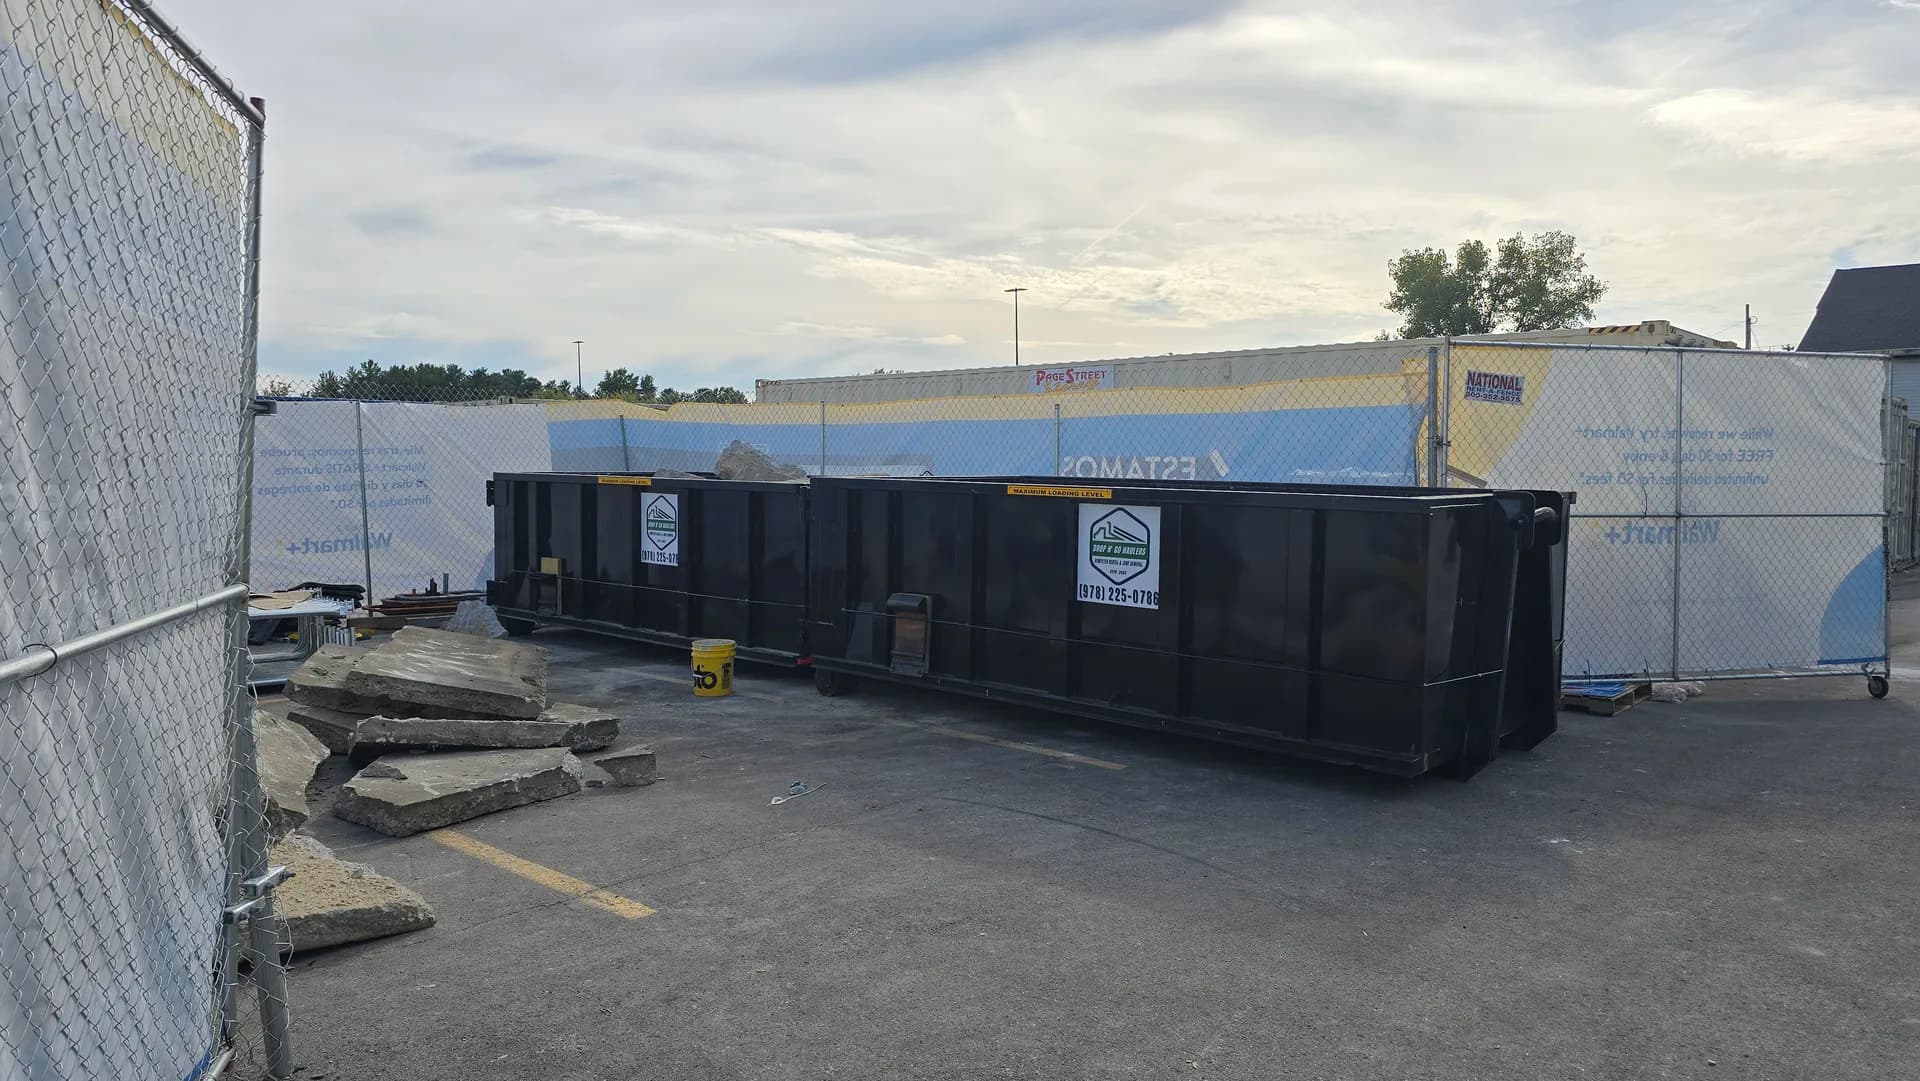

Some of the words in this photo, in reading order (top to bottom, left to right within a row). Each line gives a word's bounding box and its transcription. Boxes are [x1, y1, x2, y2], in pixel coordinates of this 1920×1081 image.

[1467, 370, 1521, 391] NATIONAL
[1467, 385, 1520, 396] RENT-A-FENCE
[1013, 487, 1046, 495] MAXIMUM
[1048, 489, 1079, 497] LOADING
[1081, 490, 1105, 498] LEVEL
[1113, 545, 1122, 554] GO
[1079, 583, 1105, 601] (978)
[1108, 586, 1160, 606] 225-0786
